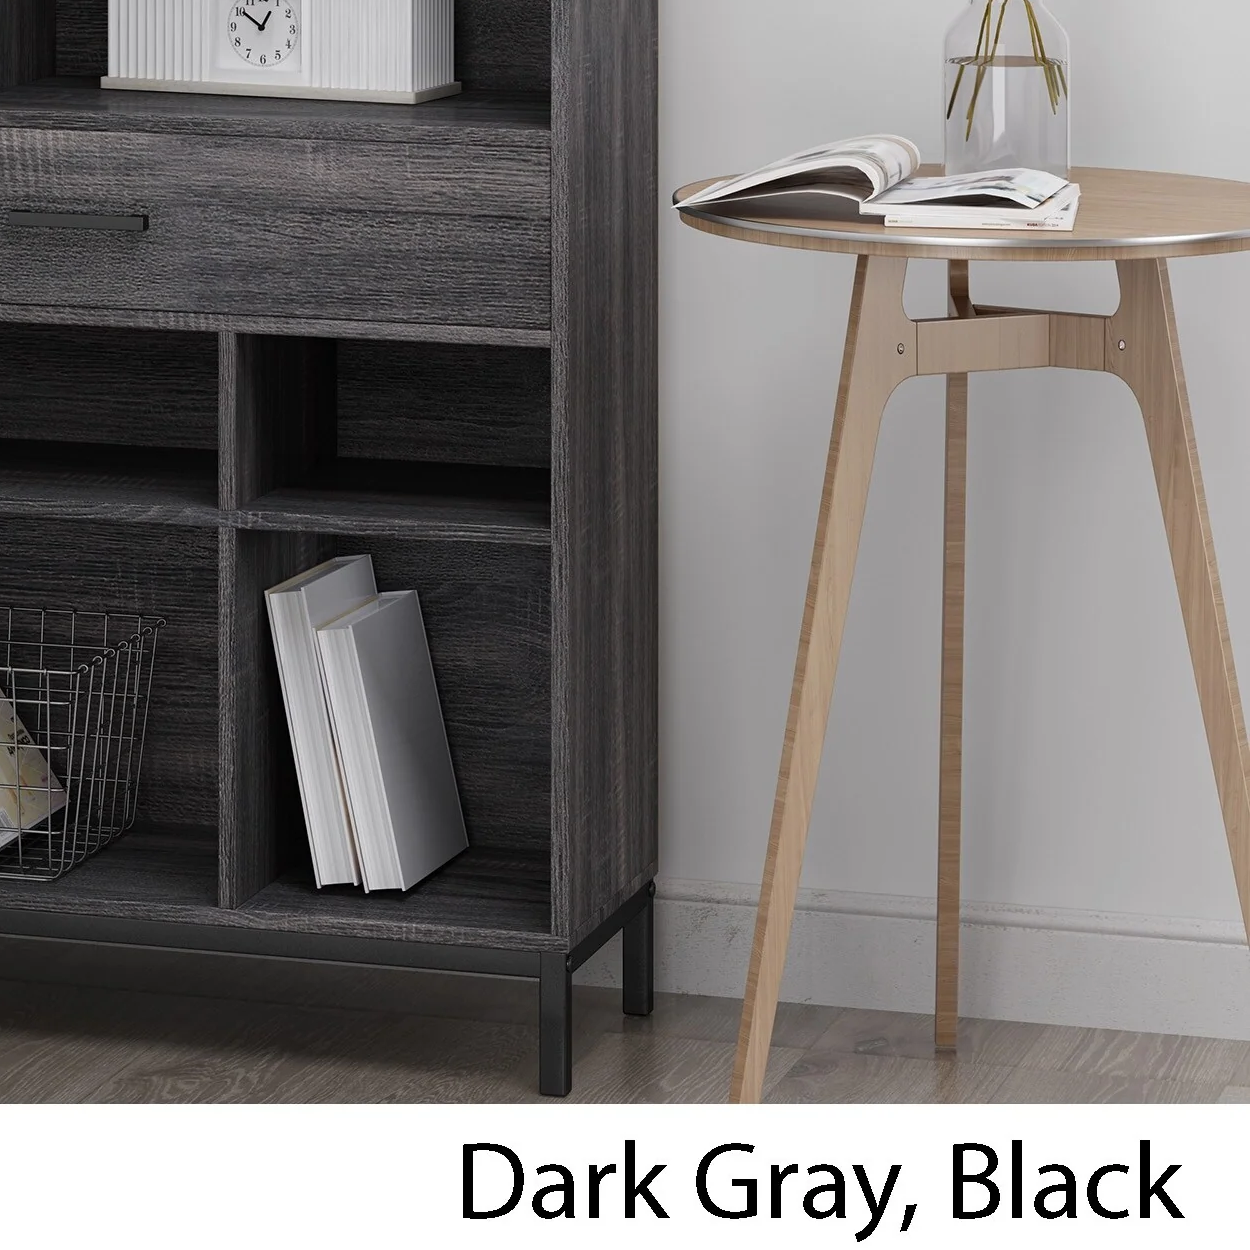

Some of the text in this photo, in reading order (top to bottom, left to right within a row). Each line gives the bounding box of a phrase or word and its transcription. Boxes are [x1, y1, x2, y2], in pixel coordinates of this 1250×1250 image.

[235, 7, 246, 17] 10
[285, 9, 292, 19] 2
[230, 22, 237, 32] 9
[289, 24, 296, 35] 3
[234, 37, 241, 47] 8
[285, 38, 292, 49] 4
[245, 48, 252, 59] 7
[274, 50, 281, 60] 5
[259, 54, 267, 65] 6
